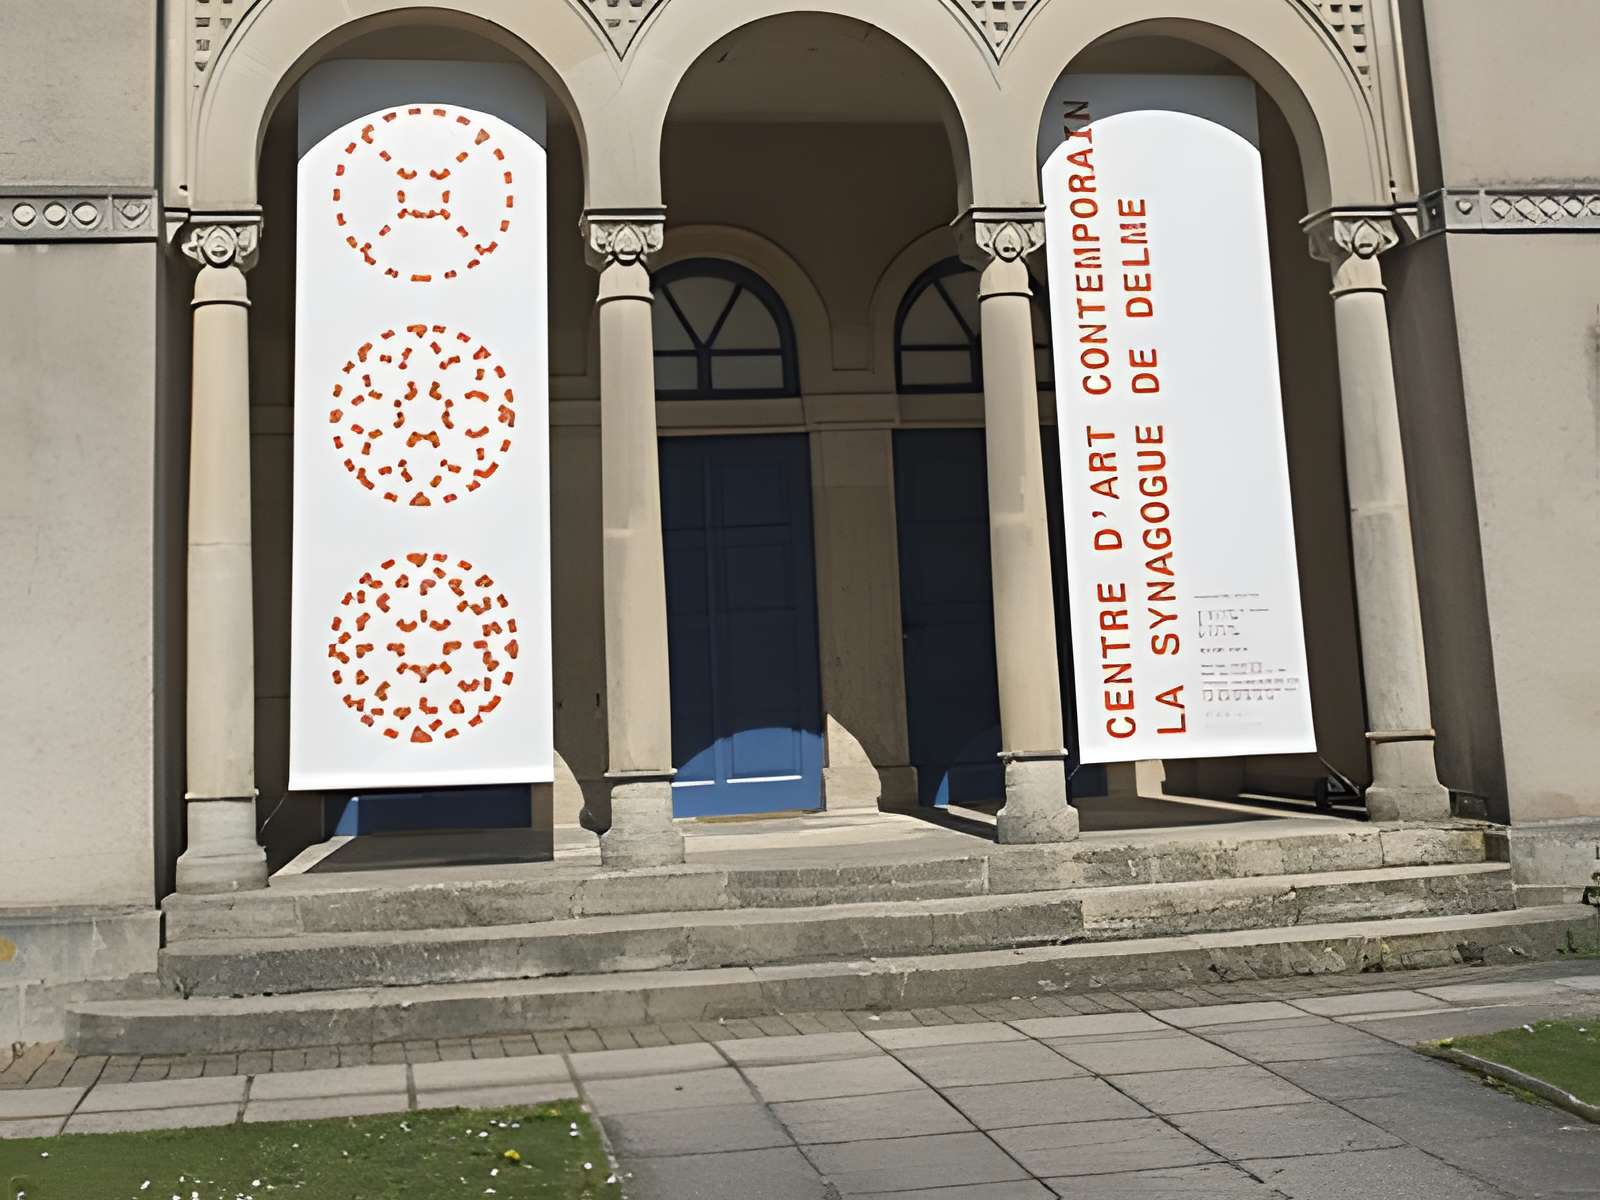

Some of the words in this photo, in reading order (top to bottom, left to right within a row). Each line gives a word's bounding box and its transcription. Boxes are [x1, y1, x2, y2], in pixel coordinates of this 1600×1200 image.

[1064, 101, 1111, 394] CONTEMPORAIN
[1118, 199, 1153, 317] DELME
[1129, 349, 1160, 394] DE
[1087, 425, 1122, 550] D'ART
[1135, 425, 1181, 655] SYNAGOGUE
[1097, 583, 1136, 738] CENTRE
[1155, 685, 1186, 734] LA
